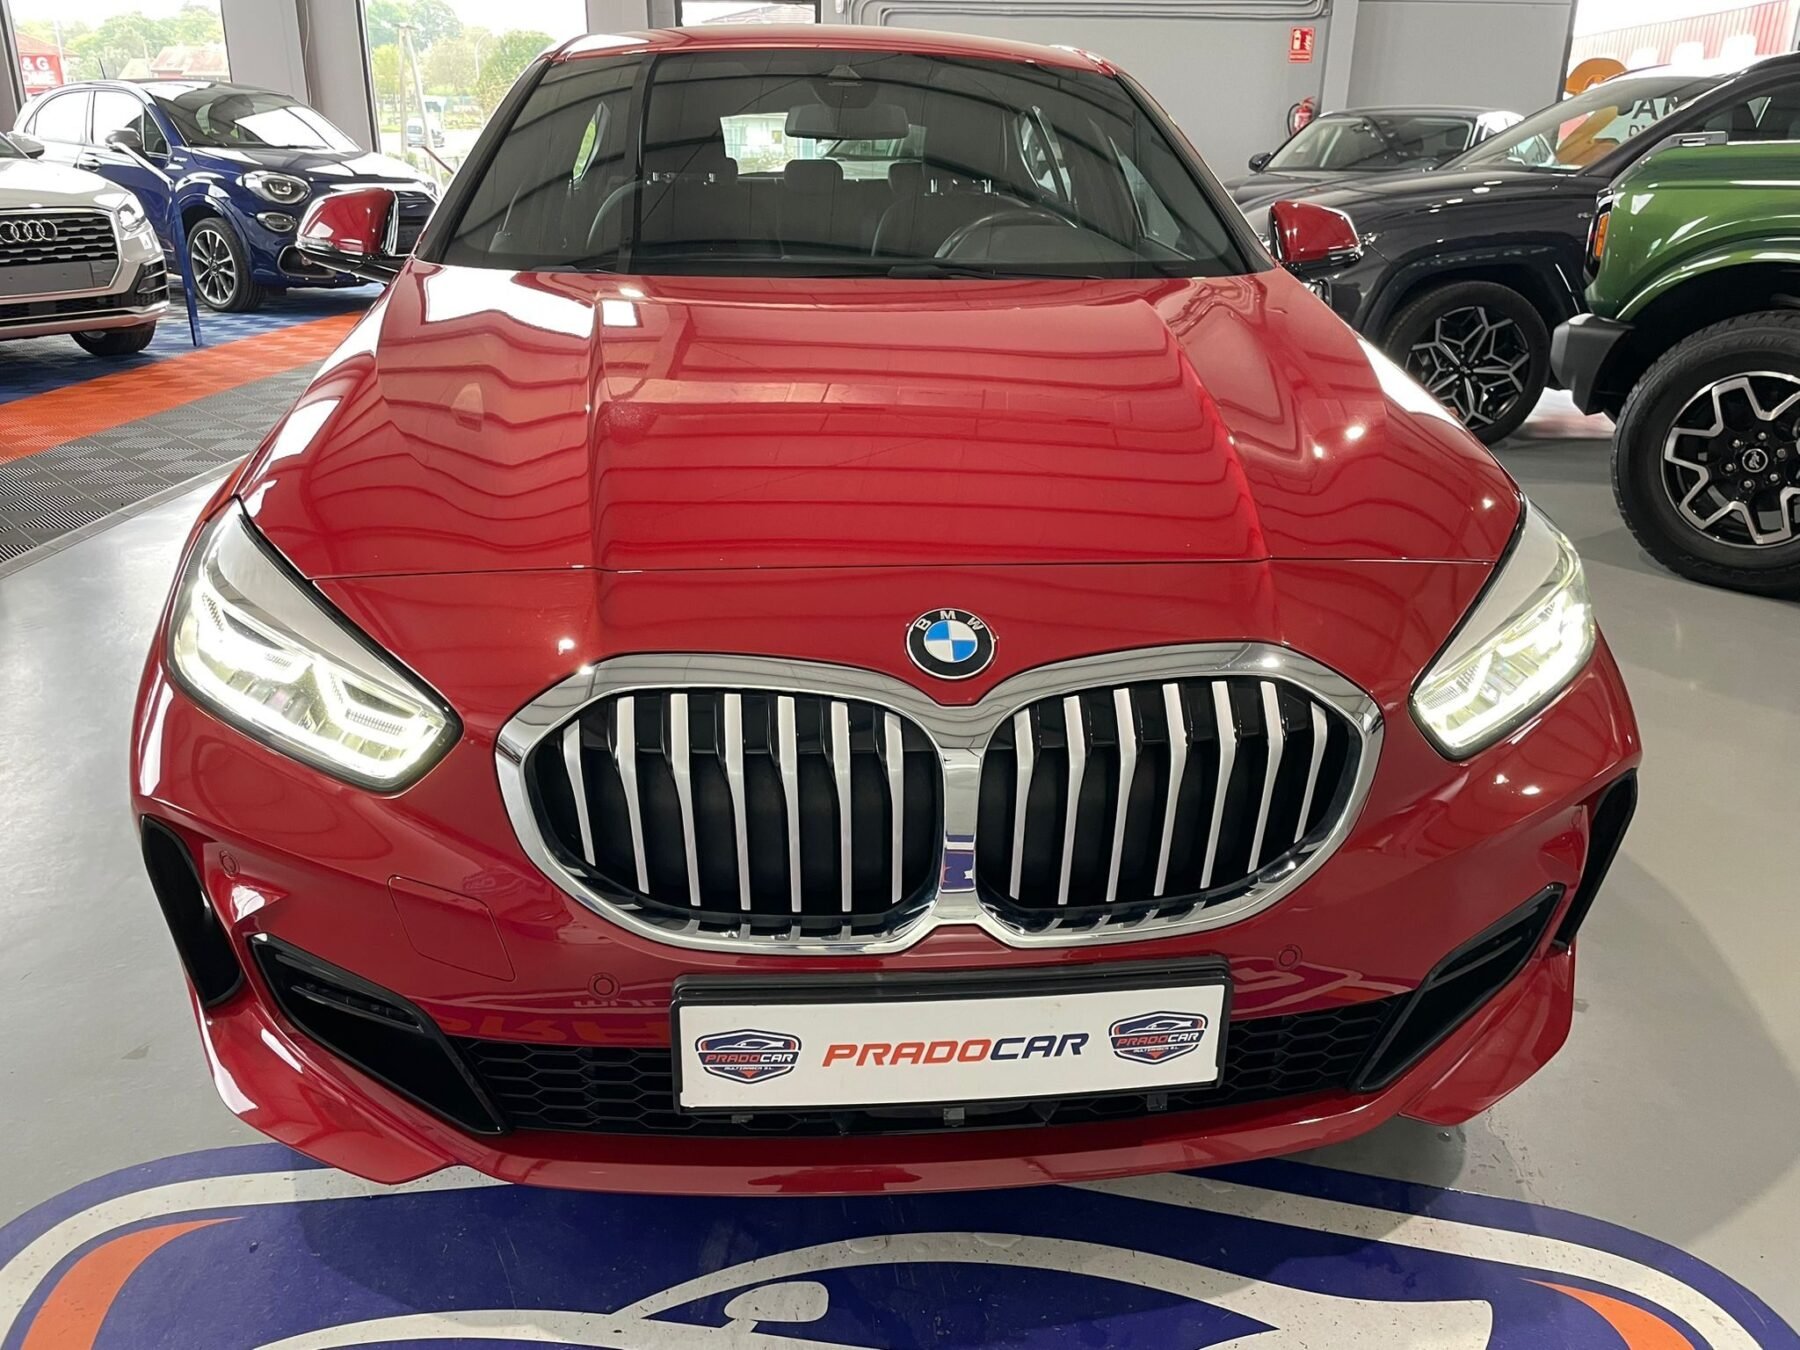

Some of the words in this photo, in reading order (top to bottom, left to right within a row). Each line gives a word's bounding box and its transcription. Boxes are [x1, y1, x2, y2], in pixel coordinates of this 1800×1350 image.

[36, 56, 50, 70] G
[914, 610, 985, 631] BMW
[1116, 1032, 1199, 1047] PRADOCAR
[822, 1033, 1089, 1067] PRADOCAR
[704, 1053, 793, 1063] PRADOCAR
